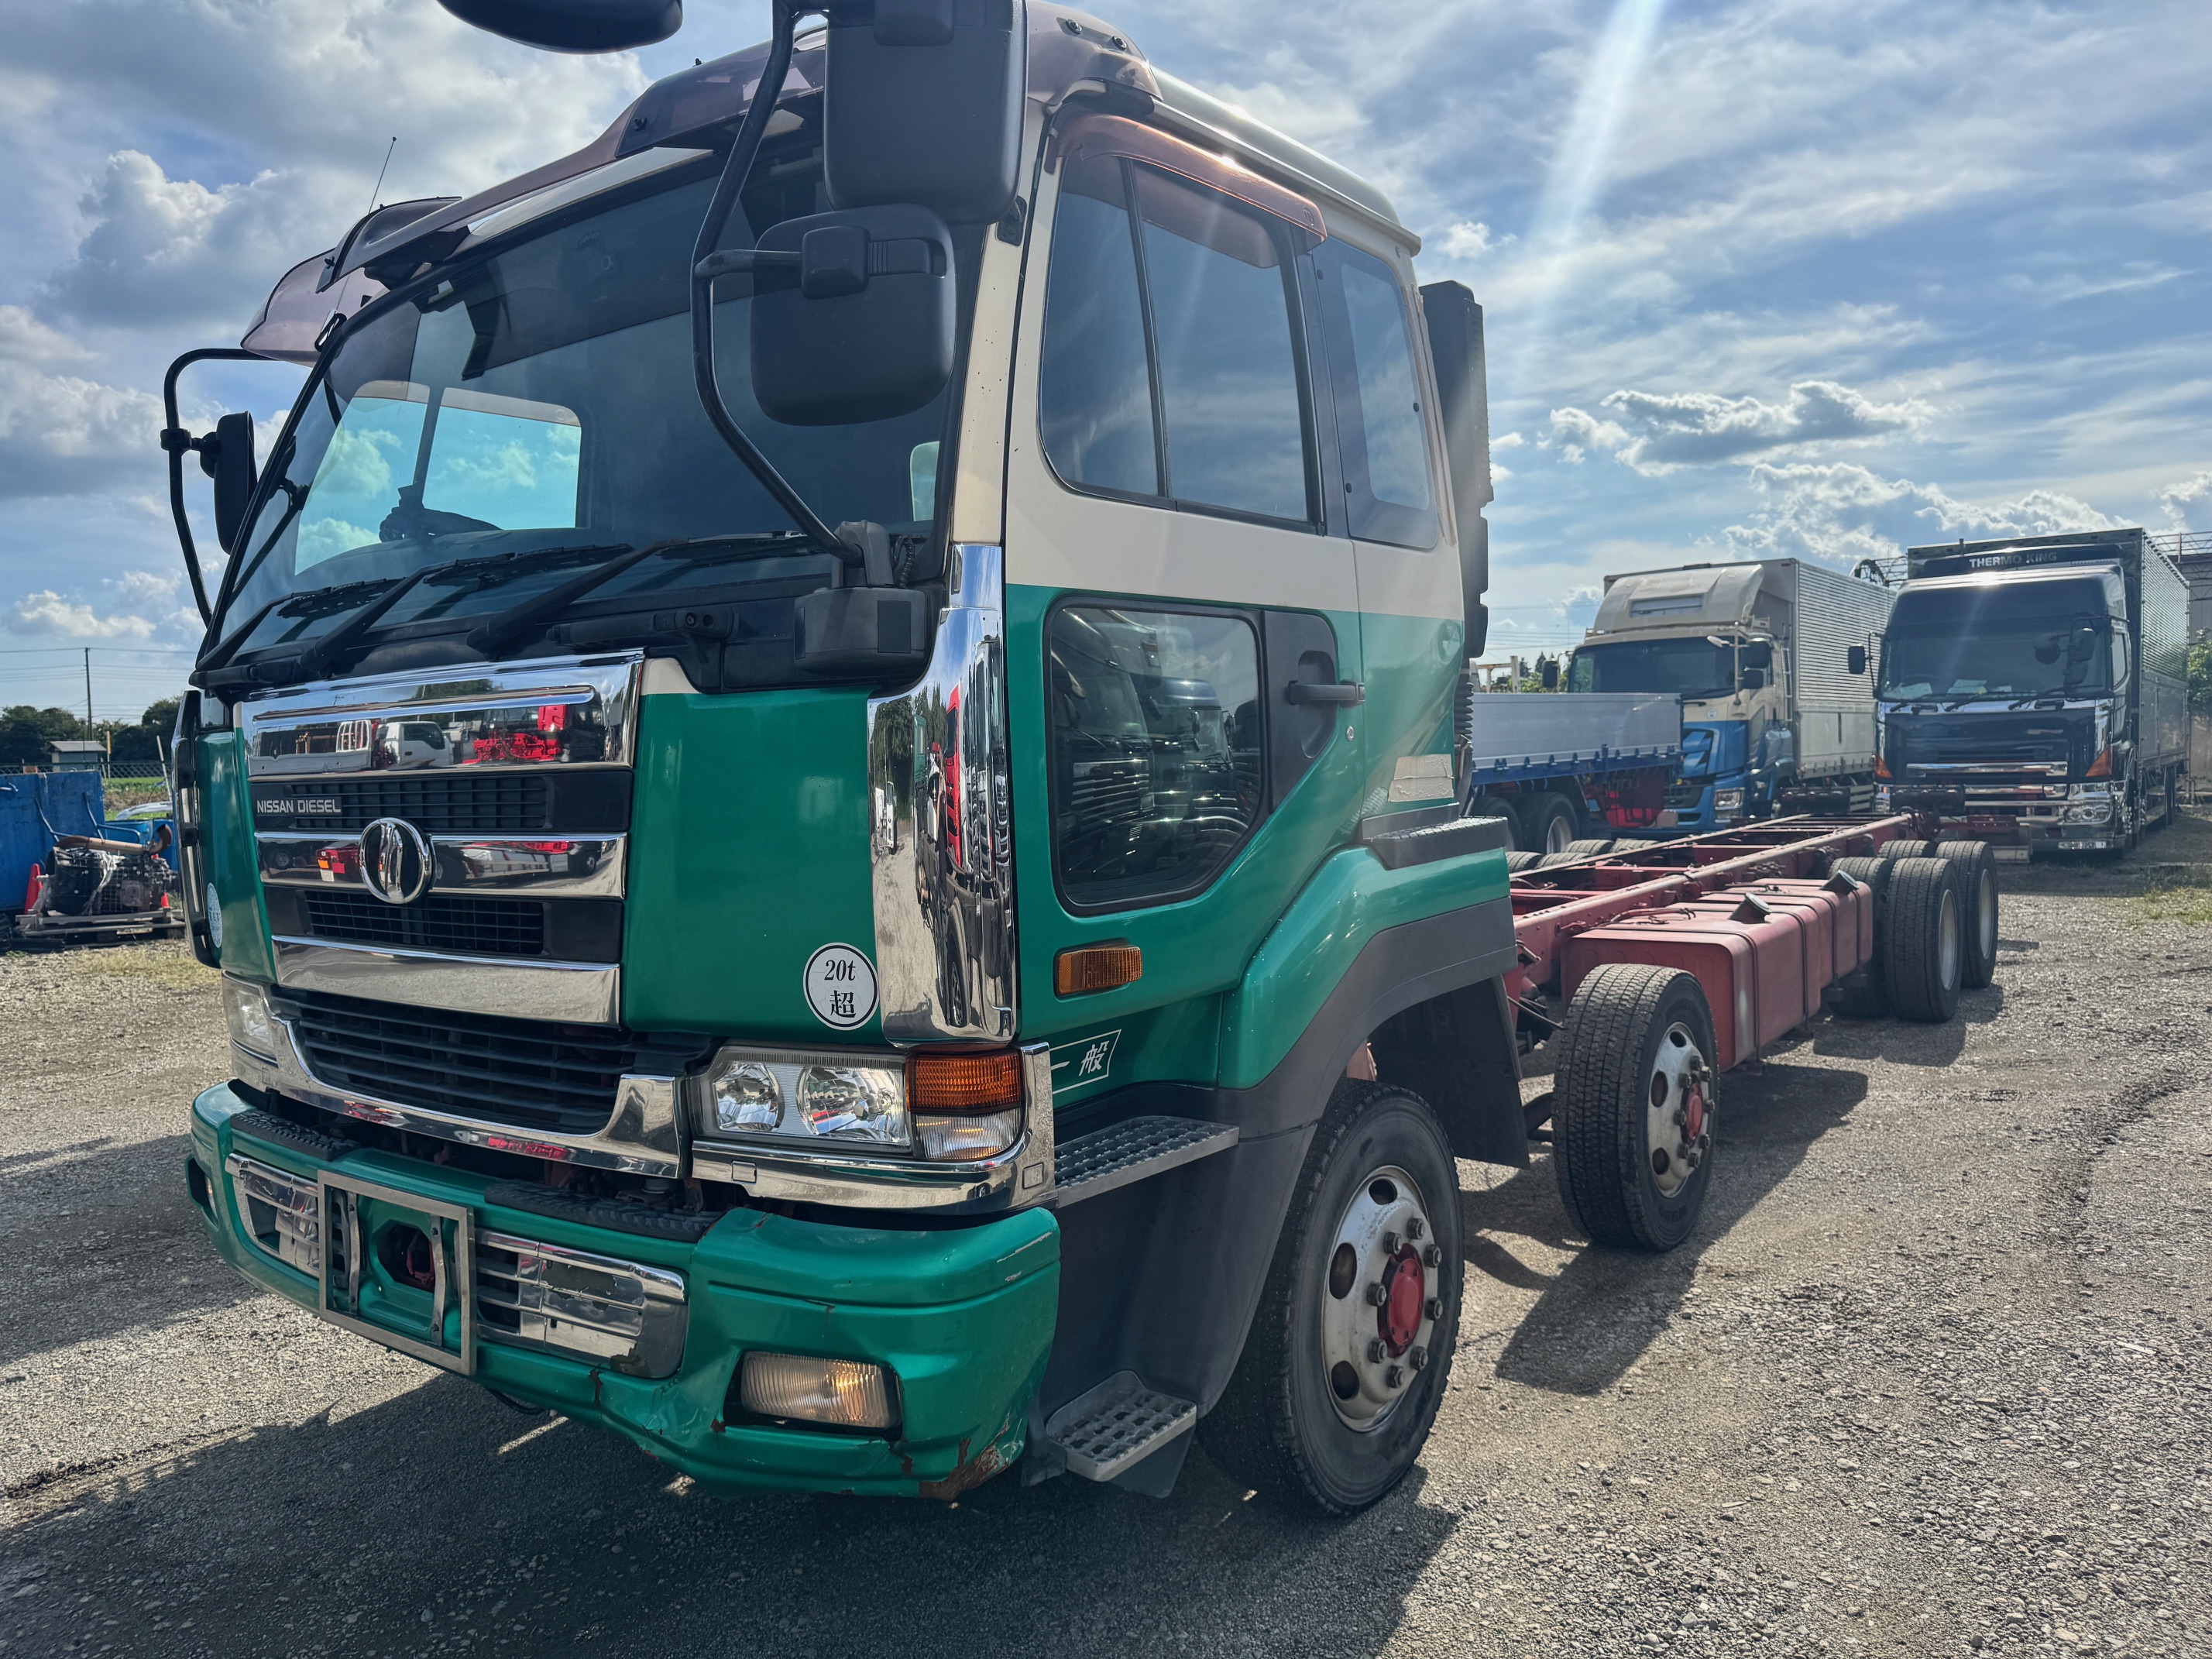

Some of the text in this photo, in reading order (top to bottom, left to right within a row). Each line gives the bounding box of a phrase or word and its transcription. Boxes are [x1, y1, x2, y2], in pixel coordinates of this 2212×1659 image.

[1969, 551, 2057, 568] THERMO KING
[256, 799, 342, 813] NISSAN DIESEL
[824, 960, 857, 981] 20t
[829, 990, 857, 1018] 超
